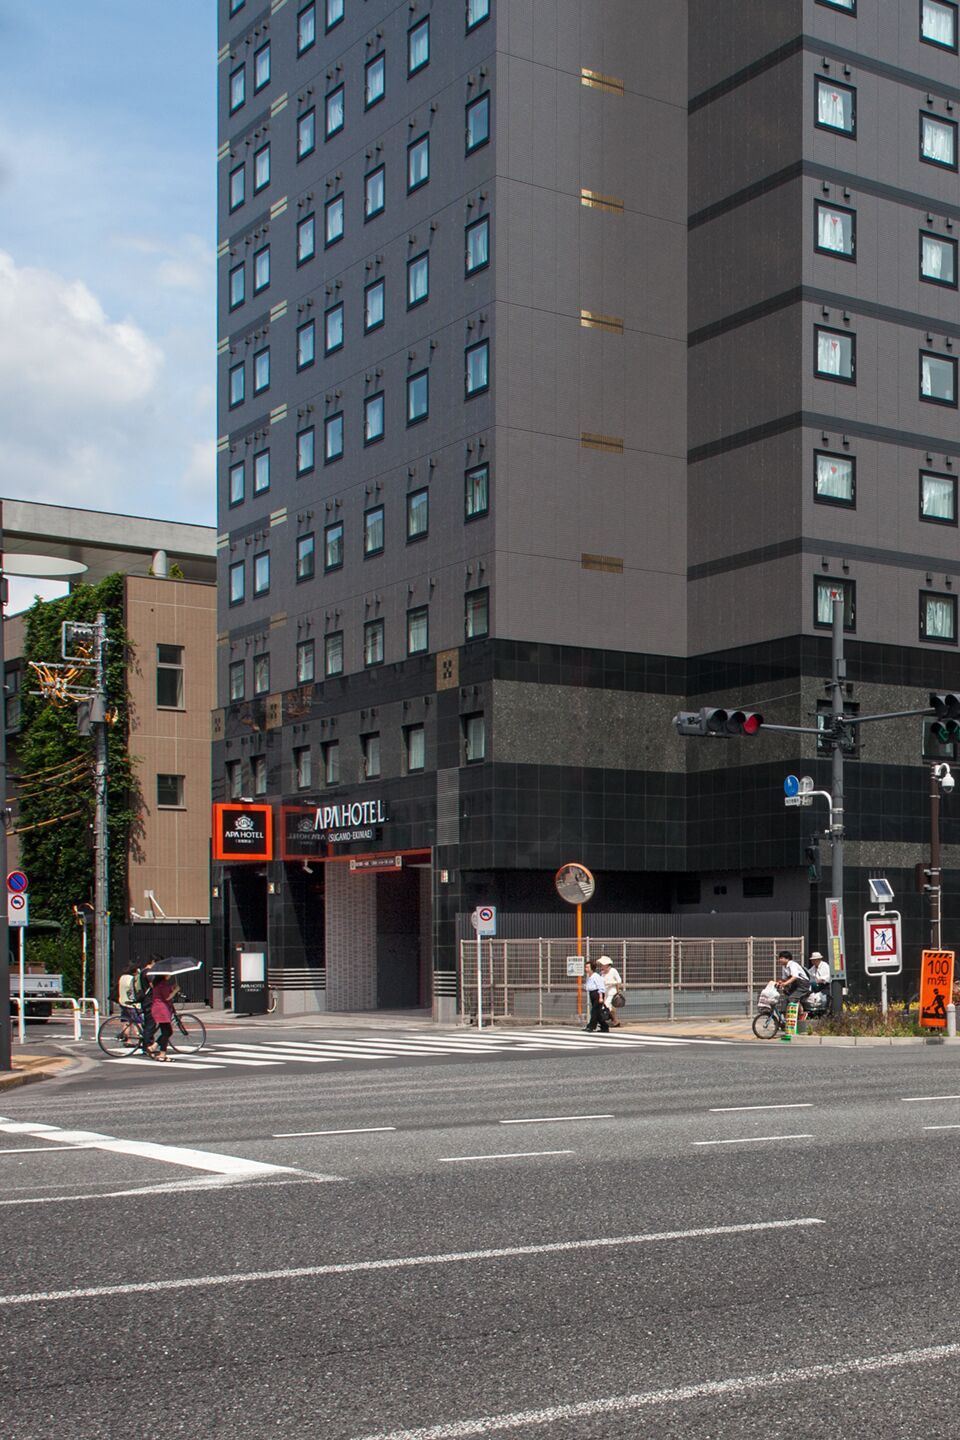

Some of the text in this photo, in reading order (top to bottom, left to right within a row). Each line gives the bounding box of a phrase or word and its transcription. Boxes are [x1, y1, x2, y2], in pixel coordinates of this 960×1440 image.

[315, 799, 385, 831] APA HOTEL
[225, 830, 264, 839] APA HOTEL
[928, 960, 949, 975] 100
[928, 975, 947, 986] m先
